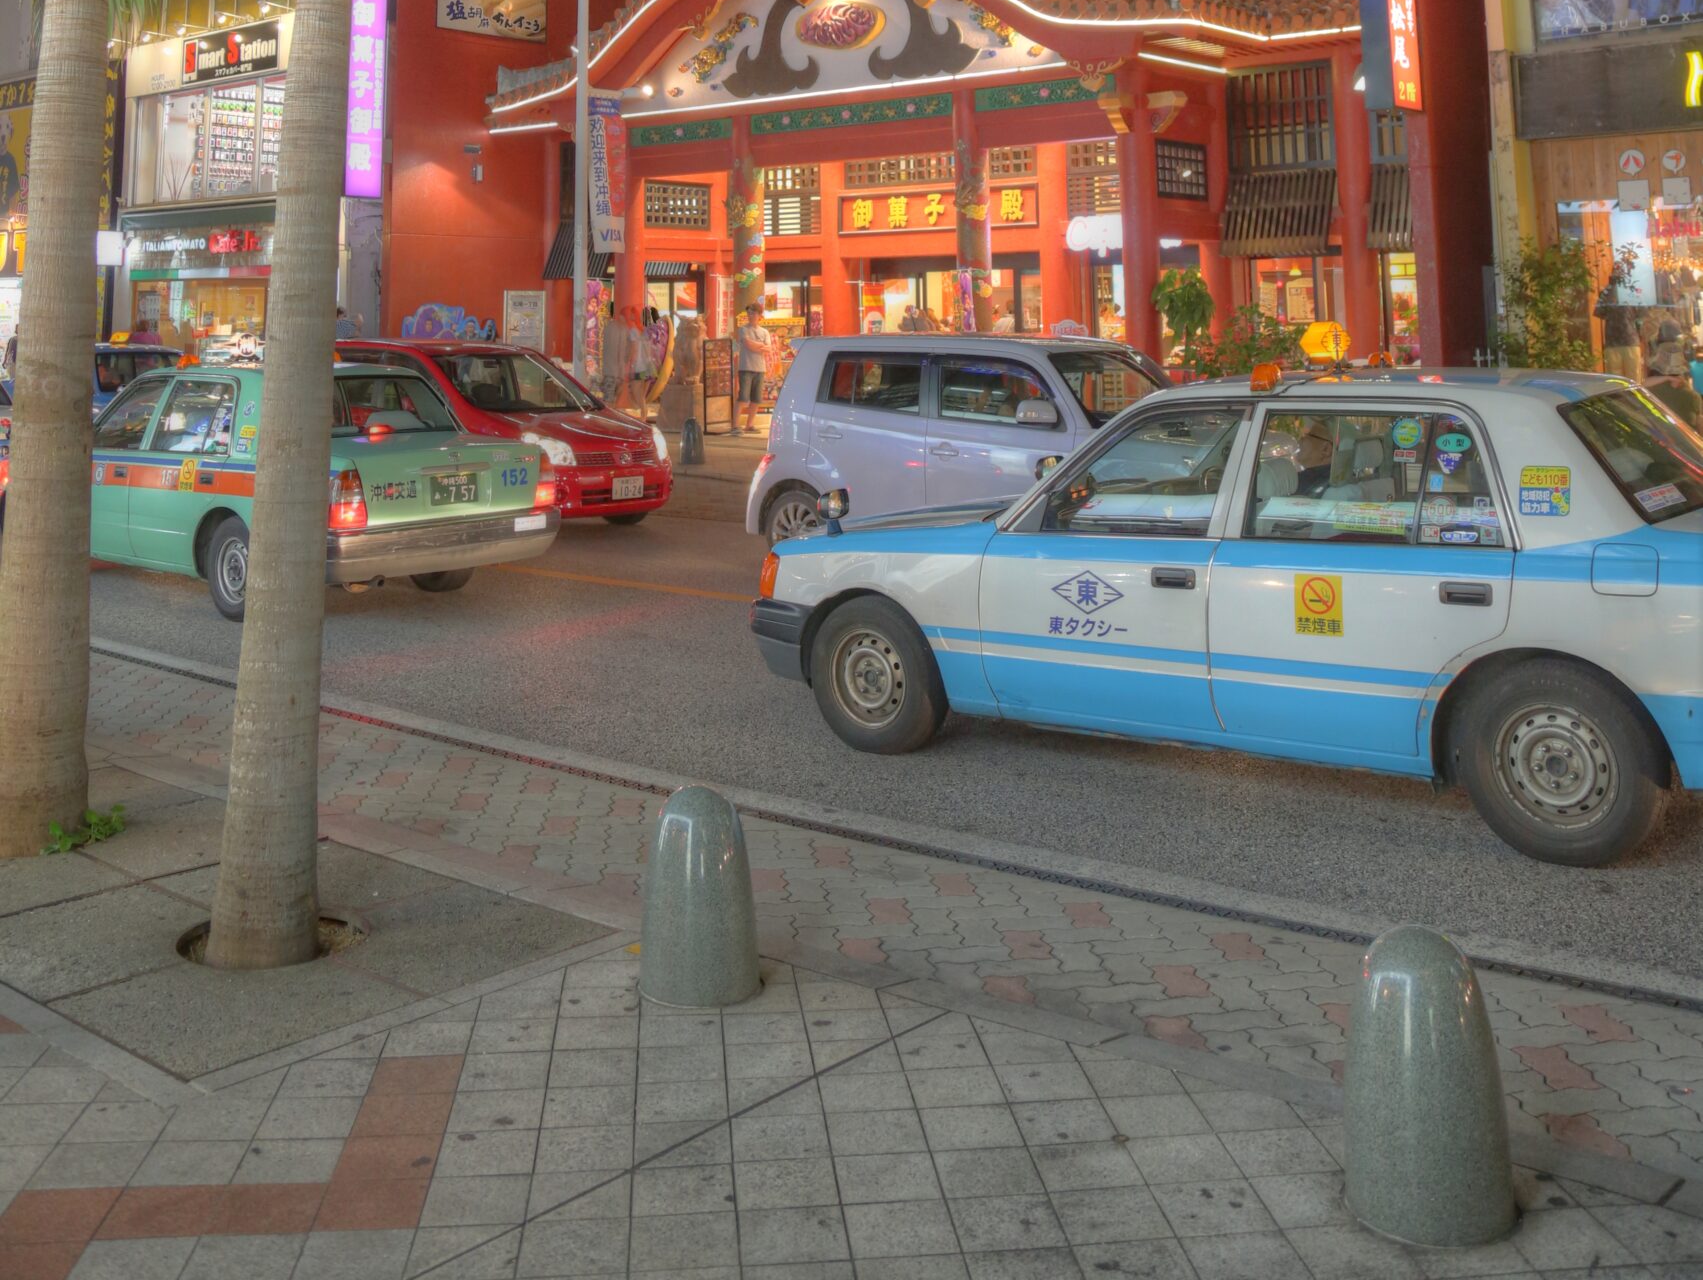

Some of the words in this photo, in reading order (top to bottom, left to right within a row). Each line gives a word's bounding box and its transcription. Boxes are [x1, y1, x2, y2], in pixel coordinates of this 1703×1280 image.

[1391, 0, 1410, 69] 松尾
[184, 41, 225, 74] Smart
[227, 32, 276, 65] Station
[1398, 79, 1417, 102] 2階
[589, 118, 612, 217] 欢迎来到冲绳
[852, 188, 1024, 230] 御菓子殿
[142, 238, 173, 253] ITALIAN
[600, 228, 622, 243] VISA
[1441, 438, 1465, 448] 小型
[502, 467, 528, 487] 152
[1521, 473, 1568, 486] こども110番
[370, 479, 417, 502] 沖縄交通
[1077, 579, 1098, 606] 東
[1048, 615, 1129, 638] 東タクシー
[1296, 616, 1341, 634] 禁煙車
